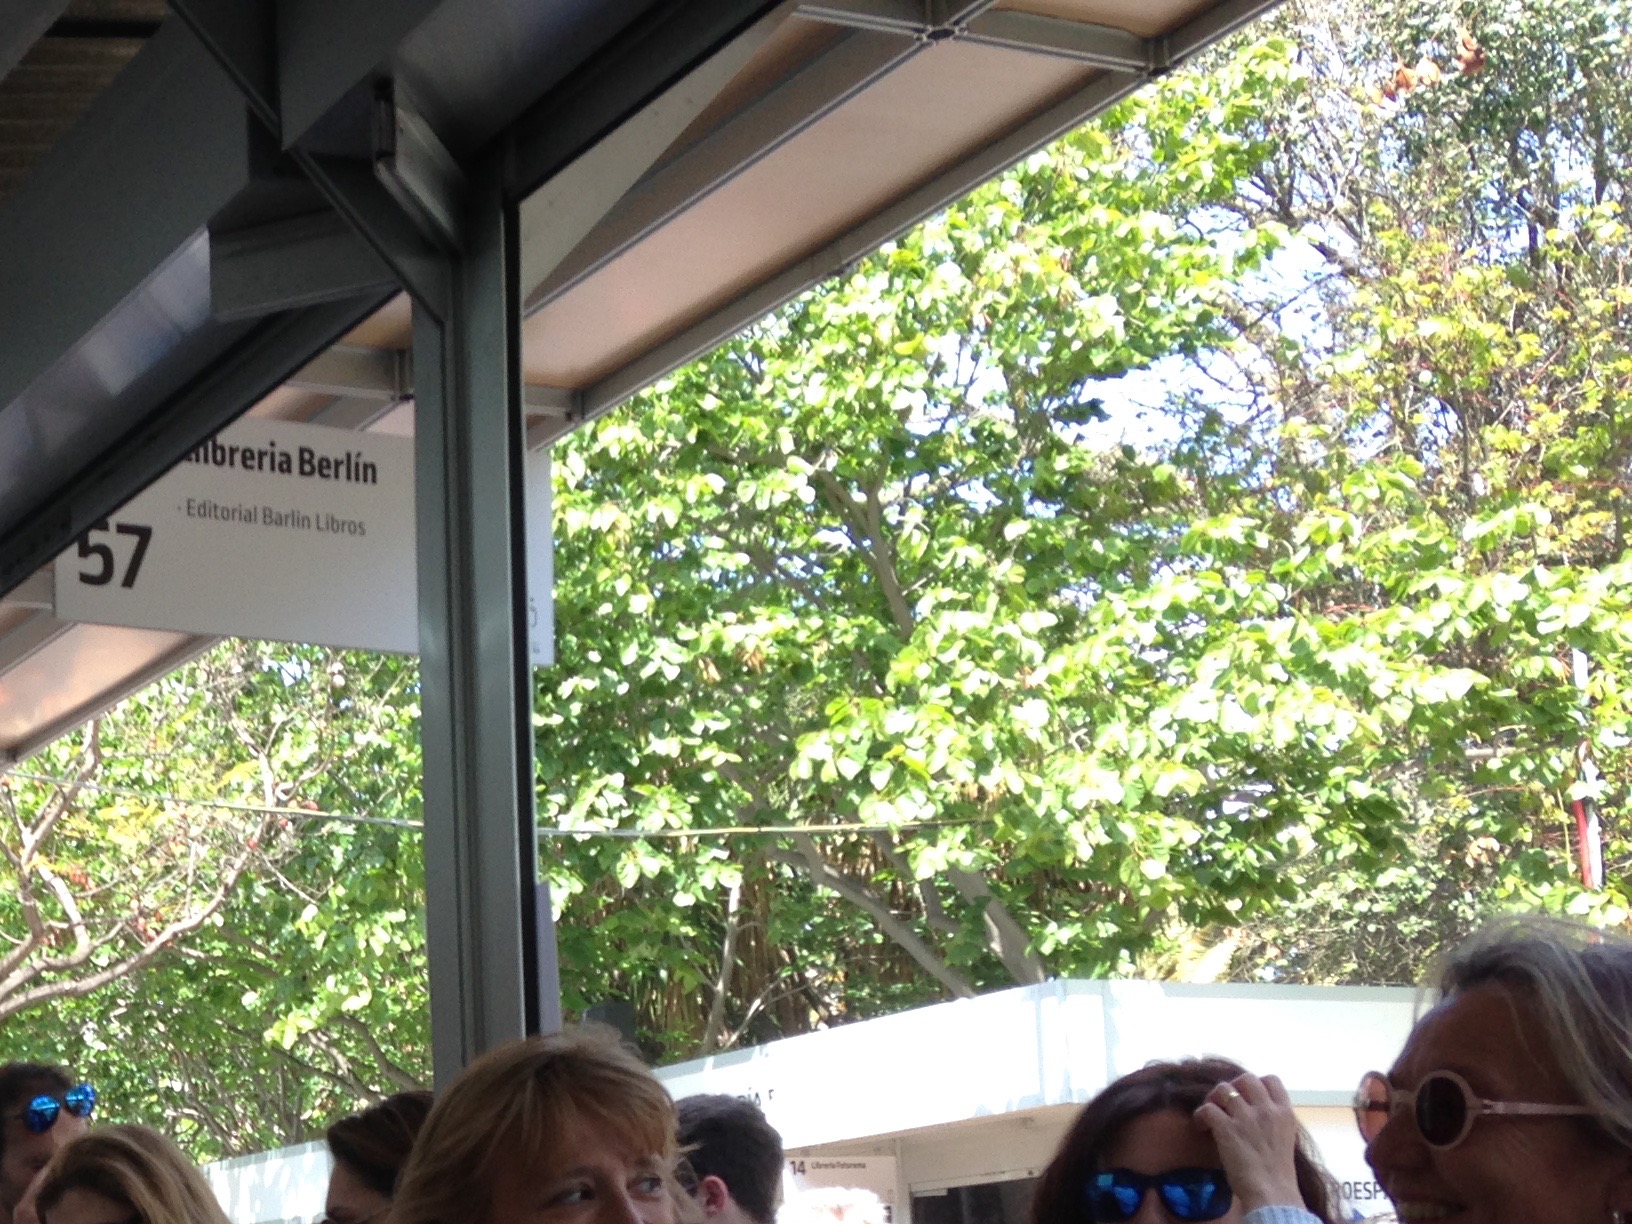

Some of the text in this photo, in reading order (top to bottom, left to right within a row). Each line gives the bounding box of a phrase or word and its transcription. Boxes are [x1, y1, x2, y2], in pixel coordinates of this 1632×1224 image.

[298, 446, 378, 484] Berlín
[186, 498, 367, 536] Editorial Barlin Libros
[77, 519, 152, 588] 57
[789, 1160, 806, 1175] 14
[1341, 1181, 1387, 1200] OESP
